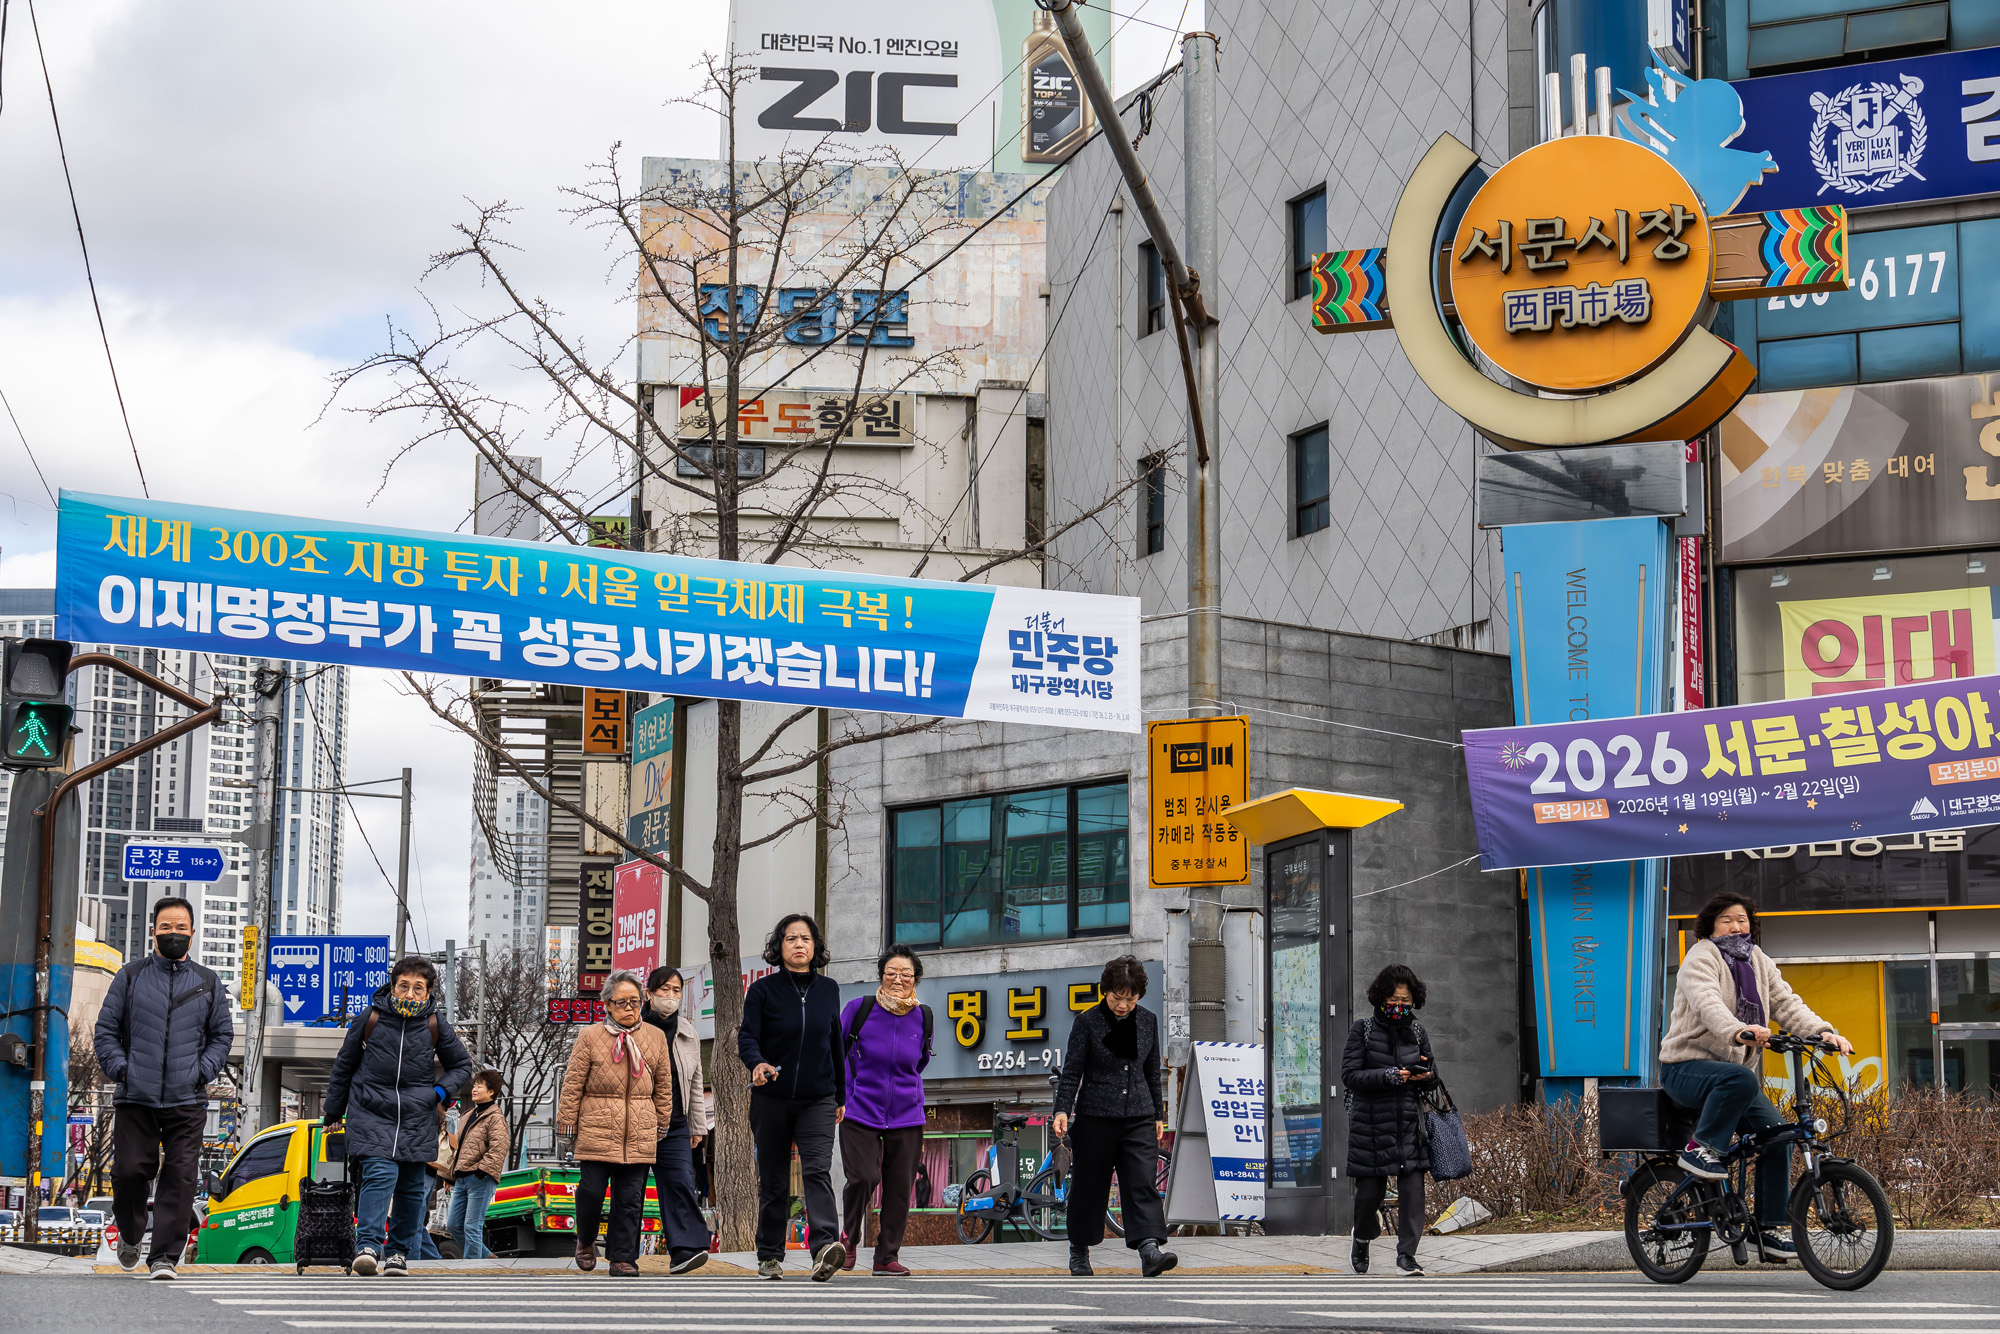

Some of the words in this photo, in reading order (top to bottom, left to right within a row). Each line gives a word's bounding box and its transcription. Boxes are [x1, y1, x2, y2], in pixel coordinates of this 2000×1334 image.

[761, 33, 834, 52] 대한민국
[839, 36, 881, 54] No.1
[886, 38, 958, 58] 엔진오일
[1033, 75, 1072, 91] ZIC
[757, 66, 959, 136] ZIC
[1845, 137, 1866, 153] VERI
[1871, 136, 1891, 150] LUX
[1871, 149, 1893, 161] MEA
[1847, 151, 1865, 164] TAS
[1458, 203, 1697, 275] 서문시장
[1768, 250, 1946, 311] -6177
[1506, 282, 1647, 329] 西門市場
[1760, 464, 1808, 488] 한복
[1823, 458, 1872, 484] 맞춤
[1887, 453, 1935, 478] 대여
[103, 513, 192, 562] 재계
[209, 526, 330, 575] 300조
[344, 540, 429, 587] 지방
[443, 550, 523, 596] 투자
[561, 562, 640, 608] 서울
[654, 572, 804, 624] 일극체제
[818, 588, 890, 631] 극복
[98, 574, 438, 654] 이재명정부가
[452, 609, 503, 661] 꼭
[1024, 611, 1065, 634] 더불어
[1566, 567, 1589, 681] WELCOME
[1008, 629, 1119, 676] 민주당
[1801, 608, 1975, 698] 임대
[1011, 674, 1113, 701] 대구광역시당
[590, 688, 622, 750] 보석
[1525, 731, 1689, 795] 2026
[1701, 688, 2000, 780] 서문·칠성야
[1617, 795, 1668, 814] 2026년
[1673, 792, 1696, 811] 1월
[1700, 786, 1757, 807] 19일(월)
[1773, 781, 1798, 801] 2월
[1801, 775, 1860, 797] 22일(일)
[1164, 797, 1187, 818] 범죄
[1541, 799, 1603, 820] 모집기간
[1911, 813, 1930, 821] DAEGU
[1158, 823, 1195, 845] 카메라
[1202, 823, 1239, 843] 작동중
[130, 848, 181, 866] 큰장로
[1170, 857, 1228, 871] 중부경찰서
[128, 866, 184, 879] Keunjang-ro
[333, 946, 355, 964] 07:00
[364, 946, 386, 964] 09:00
[270, 973, 320, 988] 버스전용
[333, 970, 354, 988] 17:30
[364, 970, 386, 988] 19:30
[1573, 935, 1596, 1029] MARKET
